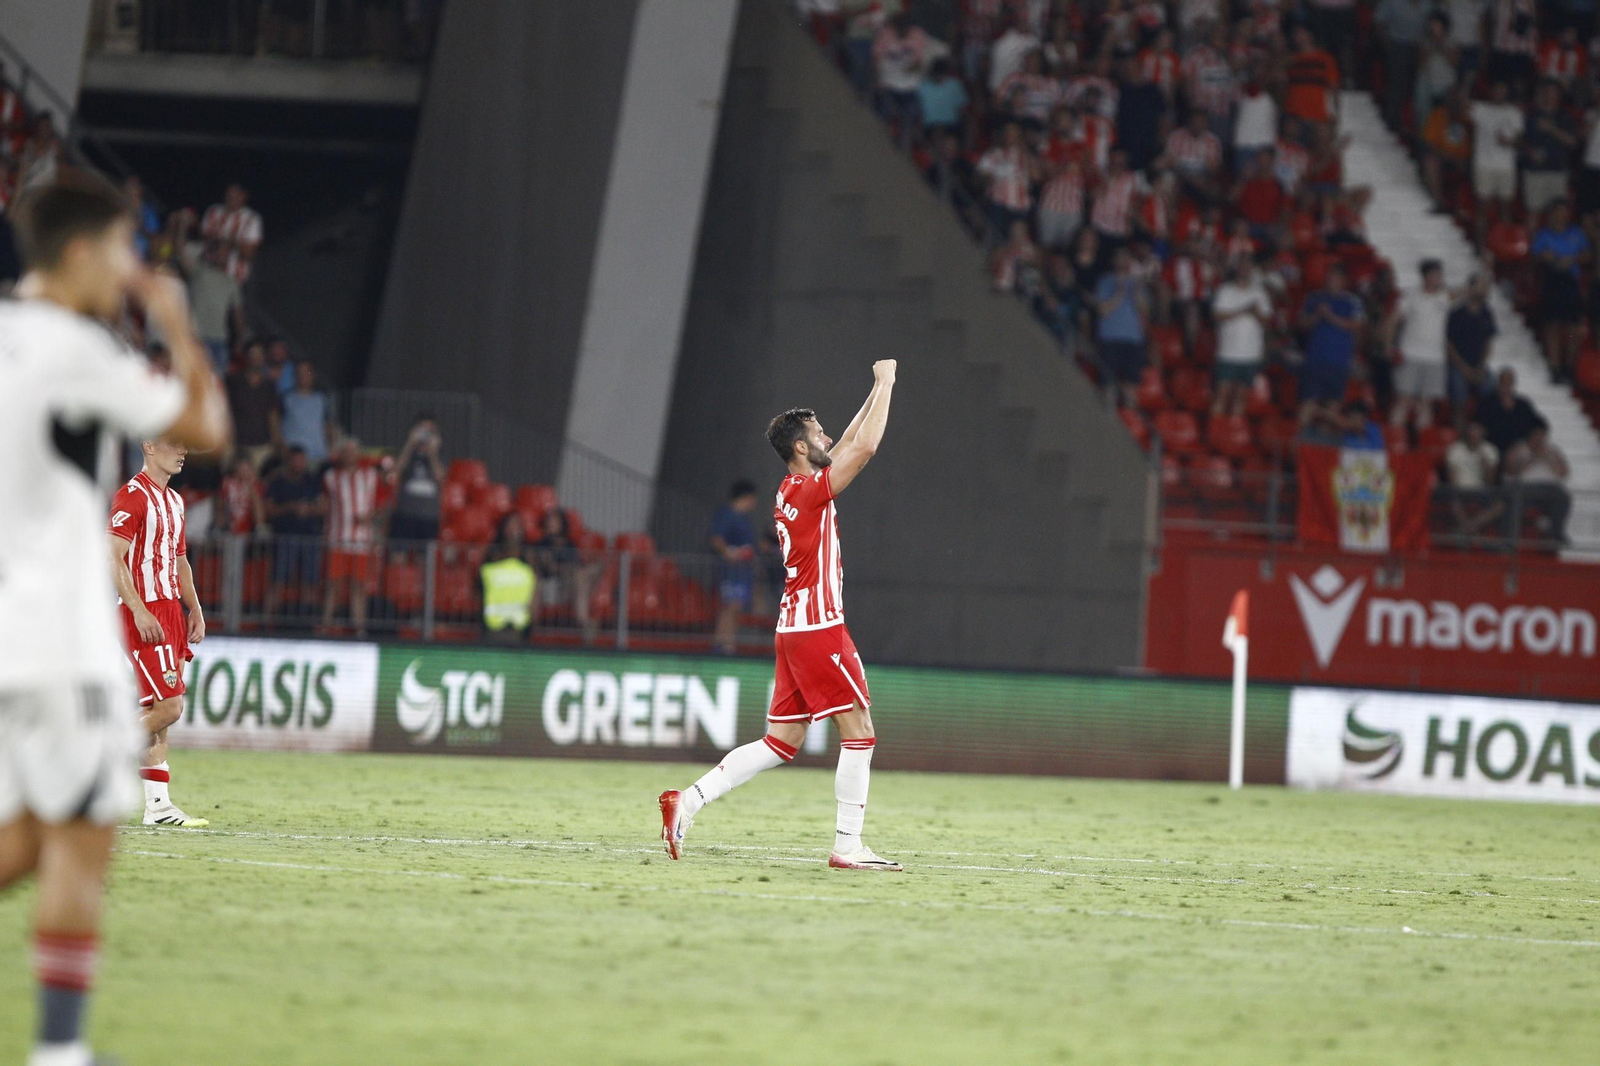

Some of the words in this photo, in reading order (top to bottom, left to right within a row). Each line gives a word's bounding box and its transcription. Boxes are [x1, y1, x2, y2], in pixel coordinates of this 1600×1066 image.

[1366, 598, 1597, 657] macron
[154, 644, 177, 672] 11
[441, 669, 506, 728] TCI
[541, 668, 740, 750] GREEN
